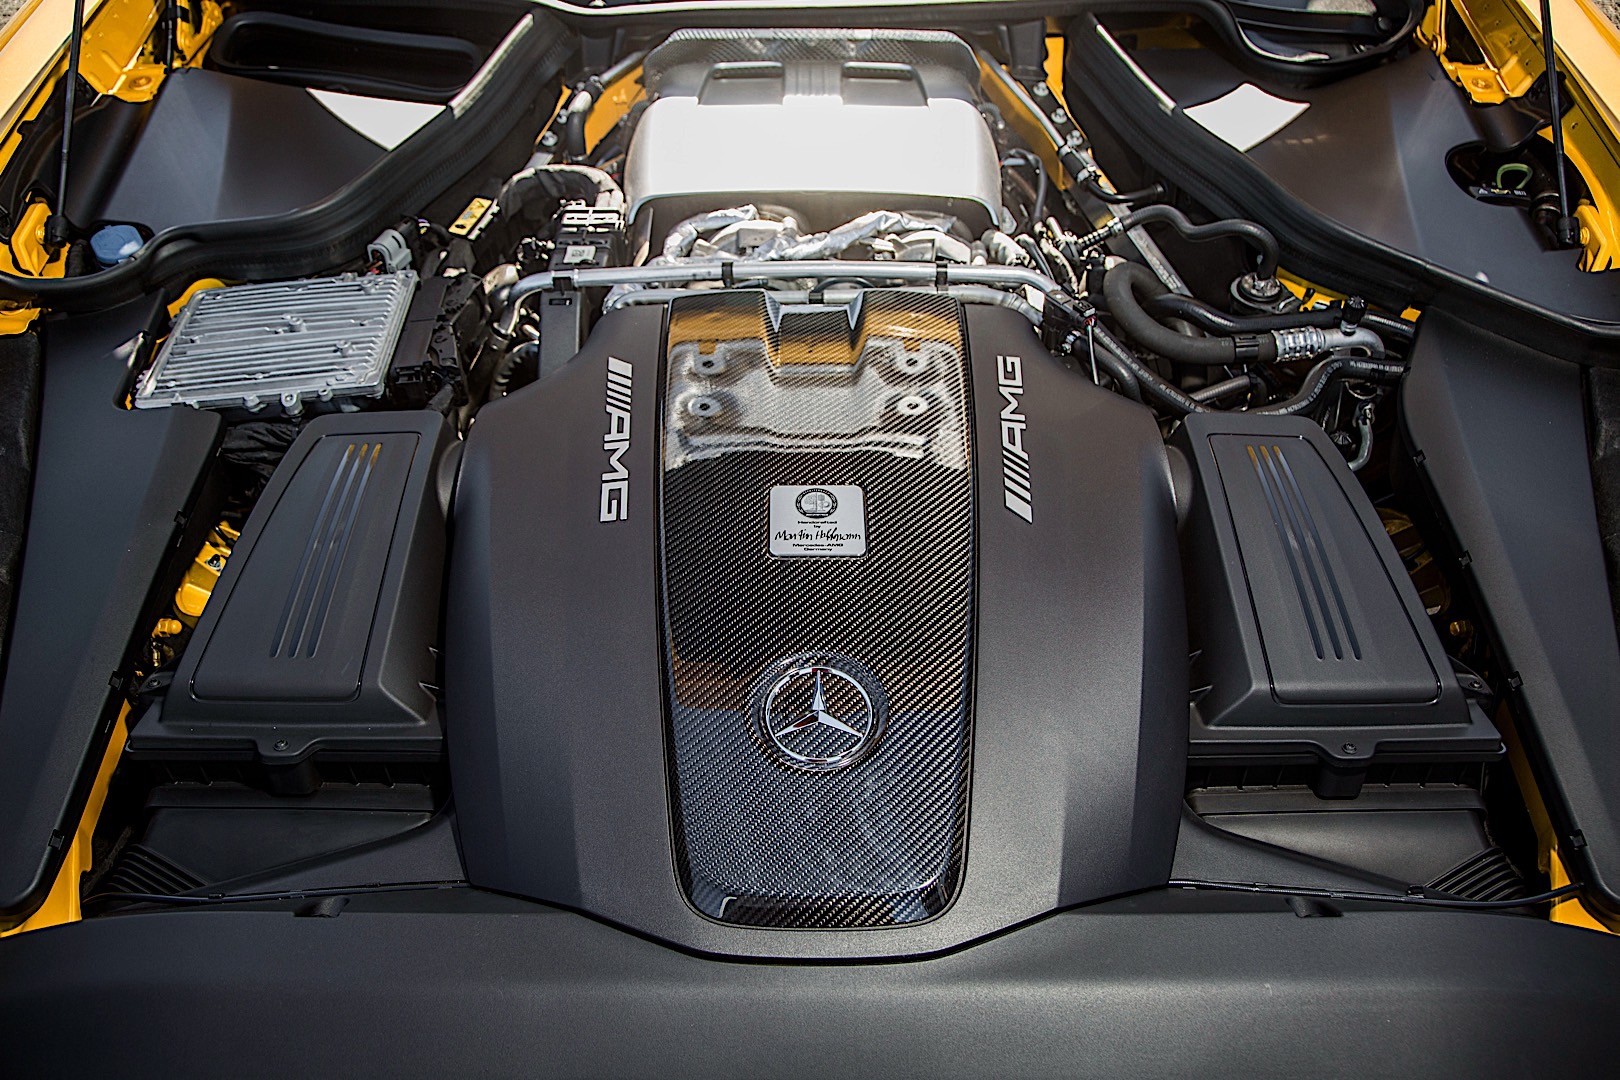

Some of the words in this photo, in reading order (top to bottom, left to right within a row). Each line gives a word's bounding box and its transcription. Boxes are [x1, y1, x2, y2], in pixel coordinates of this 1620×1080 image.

[996, 355, 1029, 462] AMG
[600, 404, 631, 522] AMG
[774, 529, 813, 541] Martin
